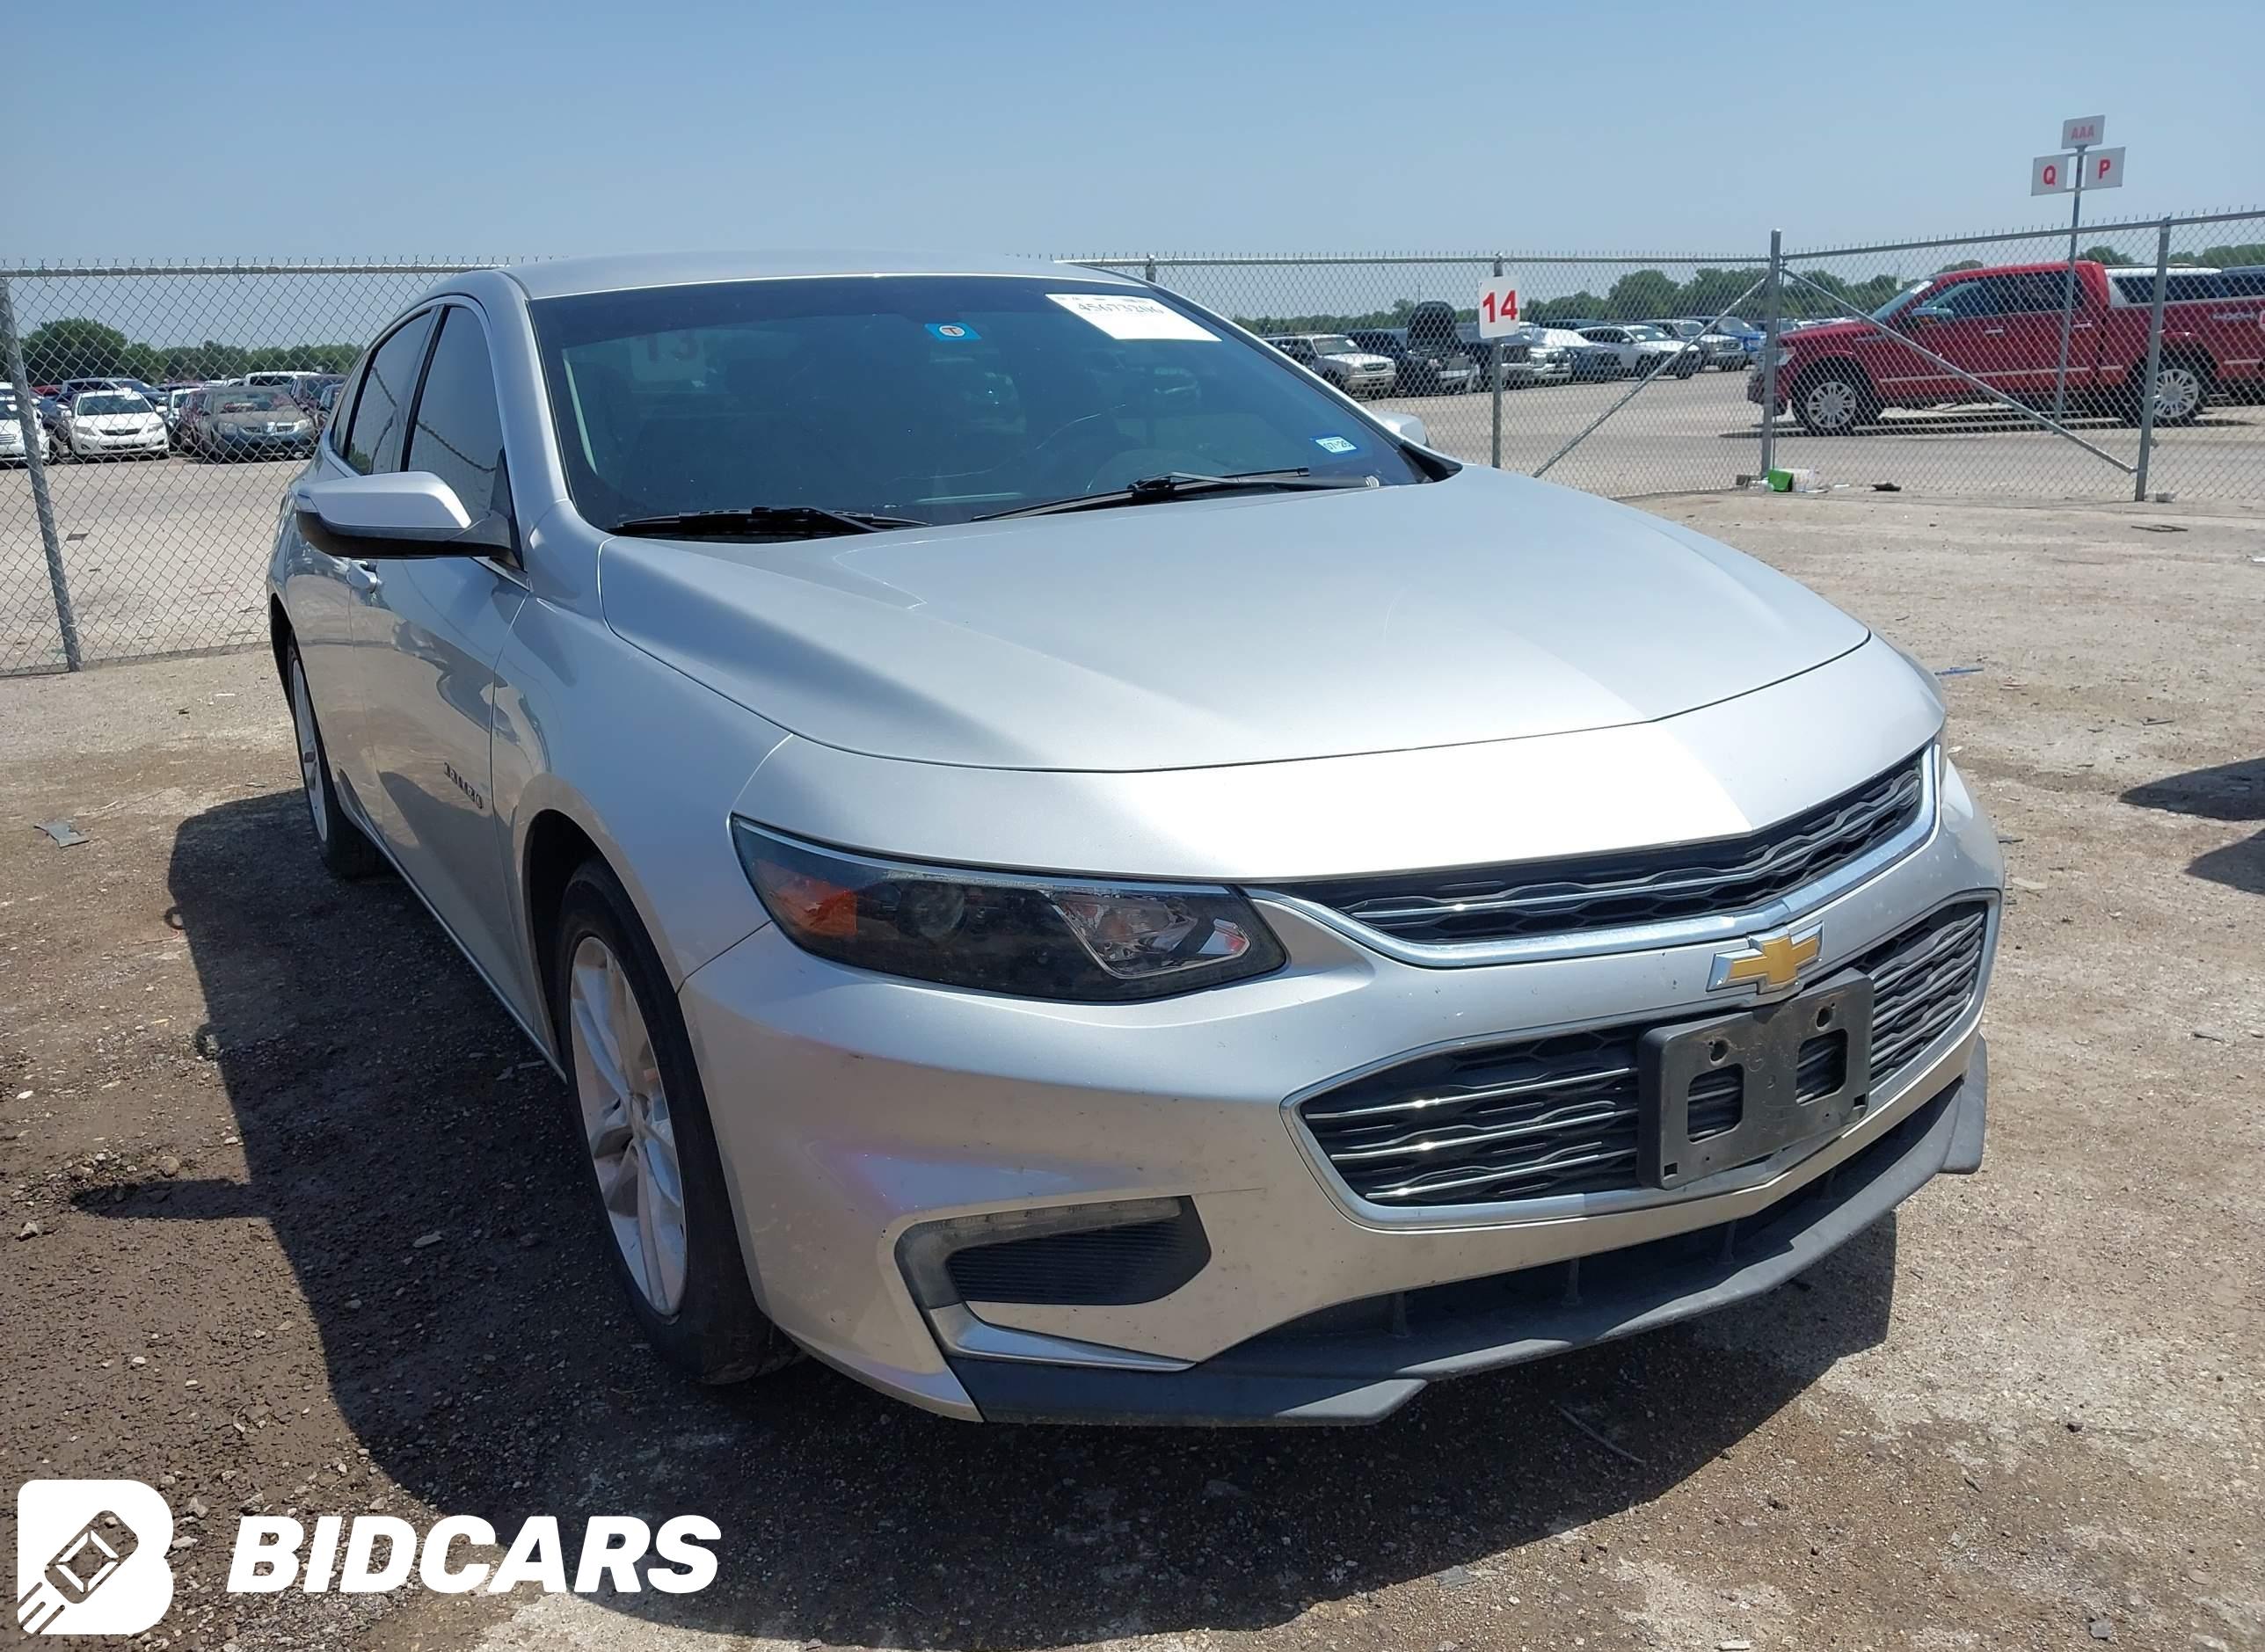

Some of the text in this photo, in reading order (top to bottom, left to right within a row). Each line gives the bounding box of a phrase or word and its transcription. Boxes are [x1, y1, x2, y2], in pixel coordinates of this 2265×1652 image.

[2071, 125, 2094, 141] AAA
[2043, 164, 2057, 186] Q
[2098, 158, 2111, 179] P
[1482, 289, 1518, 324] 14
